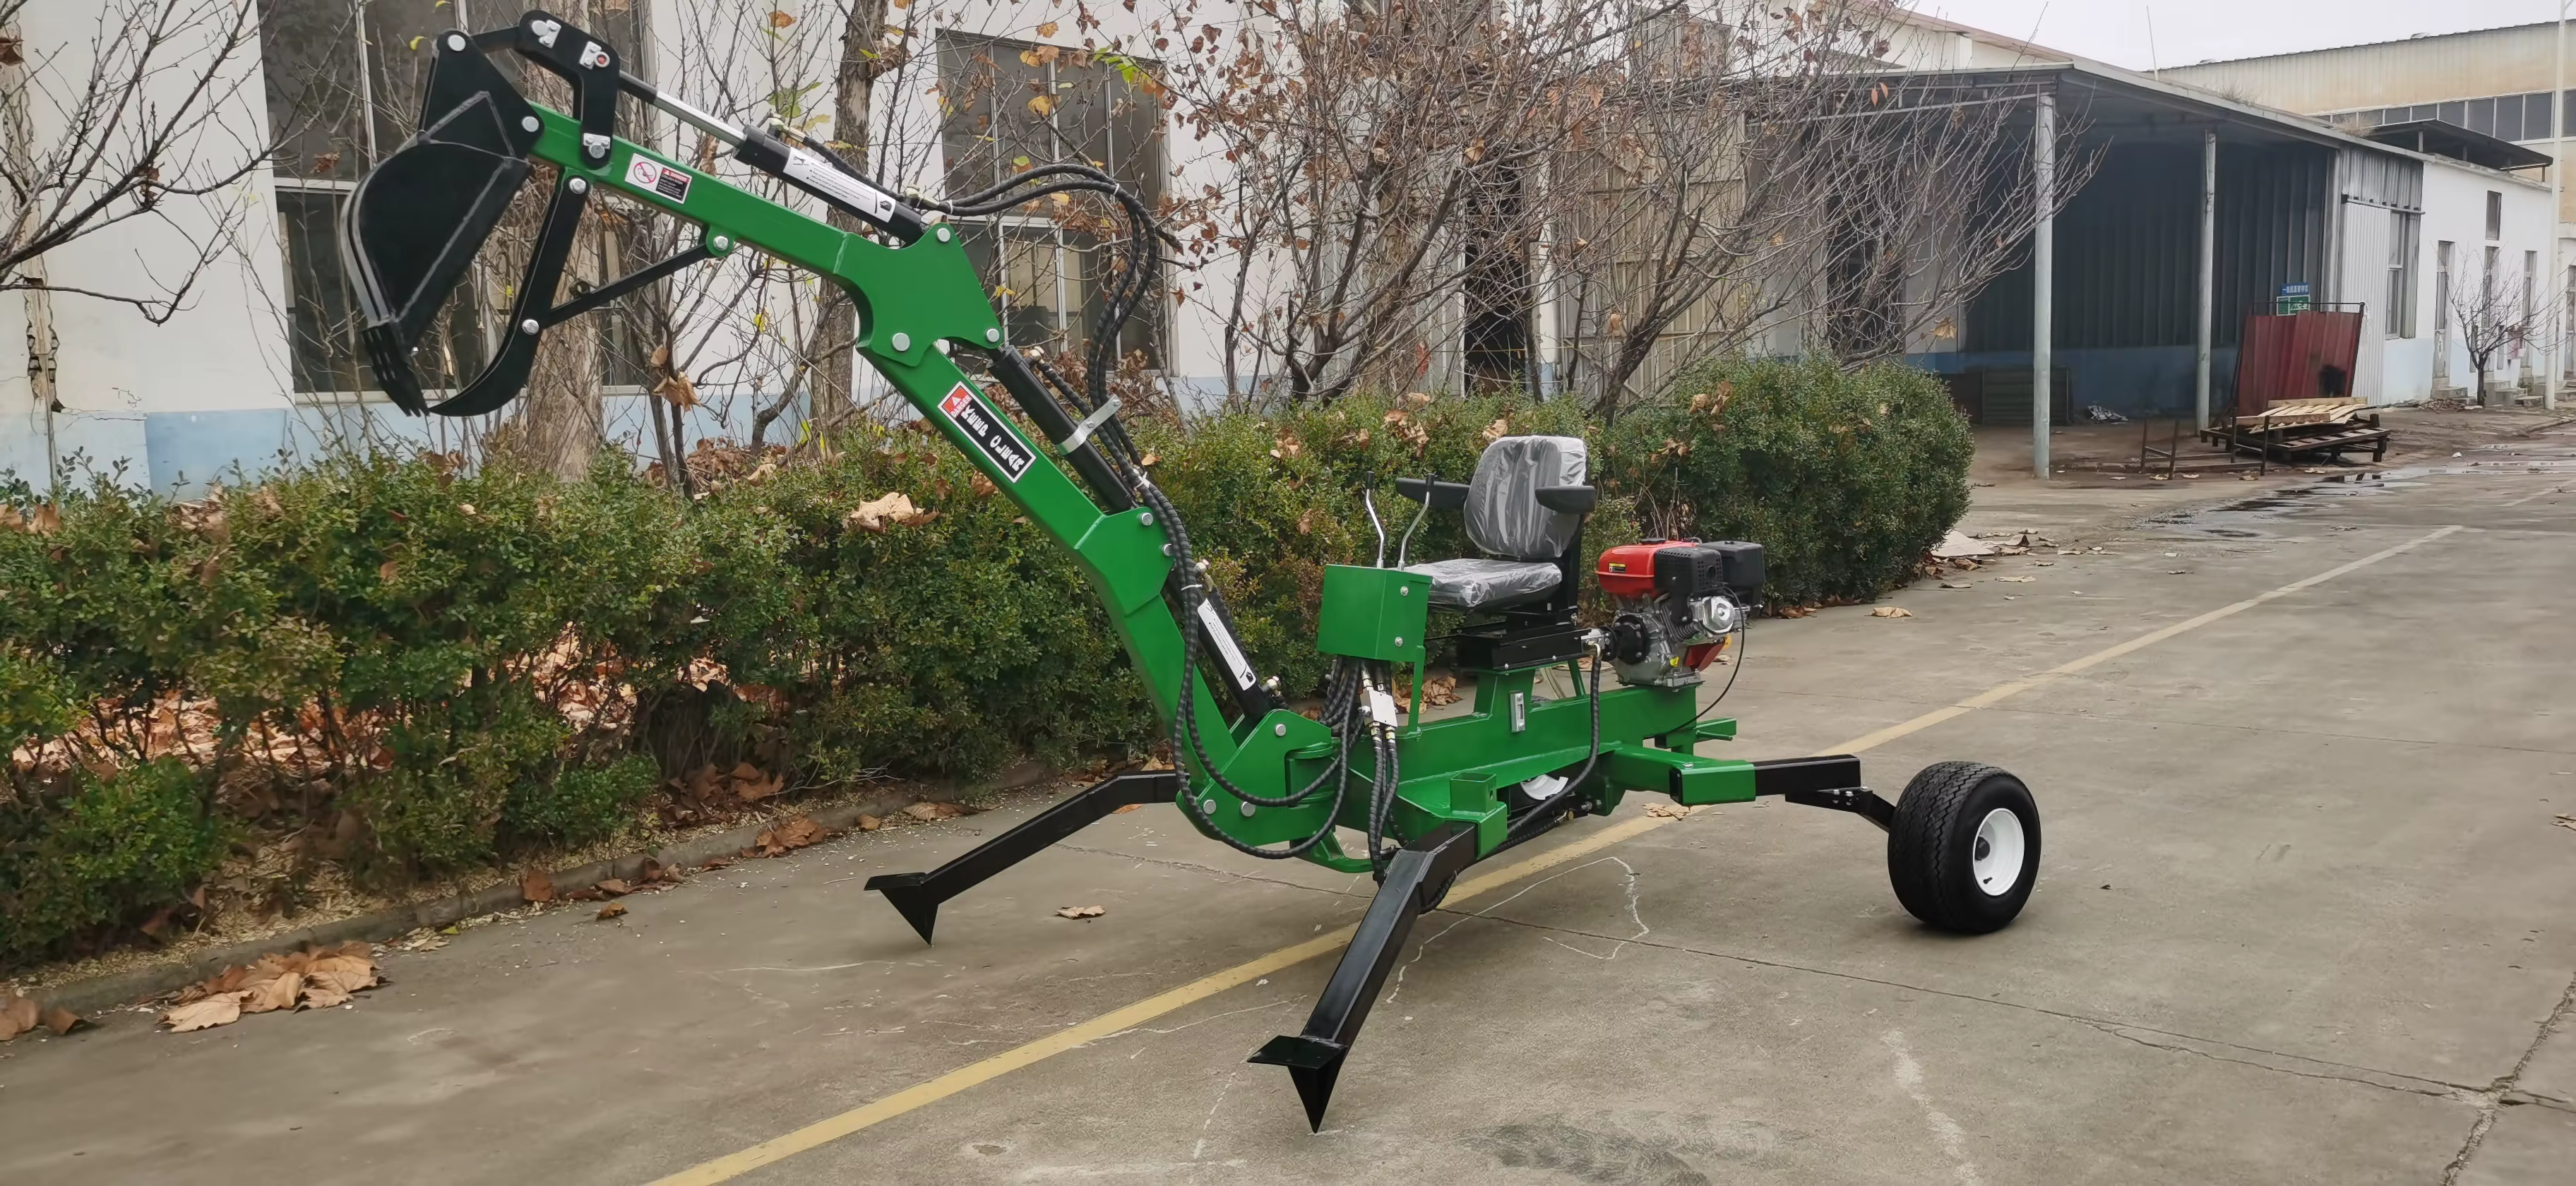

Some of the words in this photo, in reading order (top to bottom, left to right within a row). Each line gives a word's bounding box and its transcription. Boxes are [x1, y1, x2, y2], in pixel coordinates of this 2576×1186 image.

[950, 395, 972, 419] DANGER
[961, 405, 989, 437] KEEP
[990, 435, 1025, 472] CLEAR
